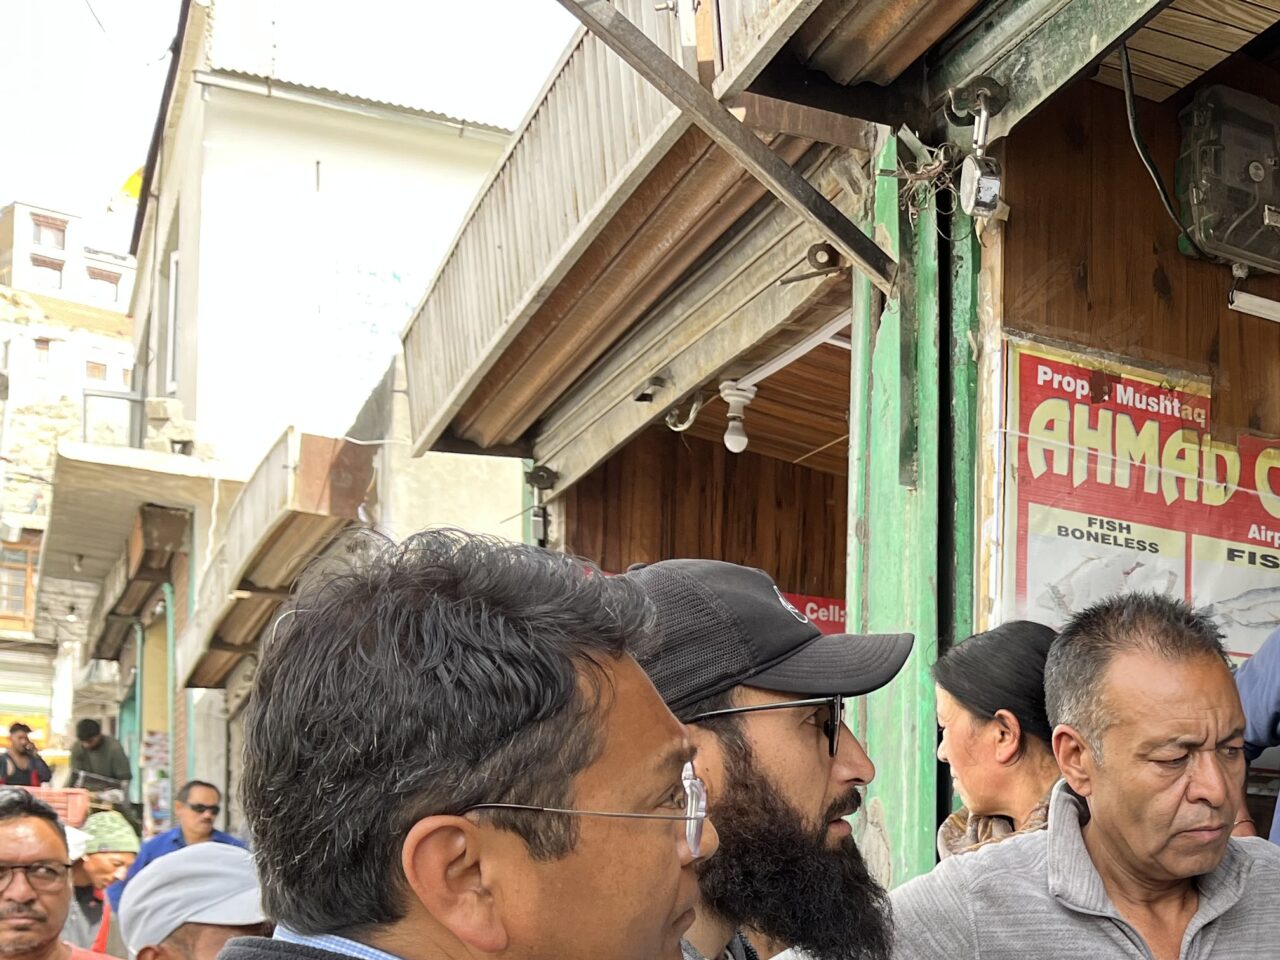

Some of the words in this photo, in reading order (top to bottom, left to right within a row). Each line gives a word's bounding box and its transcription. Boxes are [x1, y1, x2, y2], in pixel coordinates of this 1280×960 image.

[1116, 384, 1206, 428] Mushtaq
[1027, 397, 1241, 506] AHMAD
[1056, 525, 1160, 554] BONELESS
[1087, 516, 1131, 534] FISH
